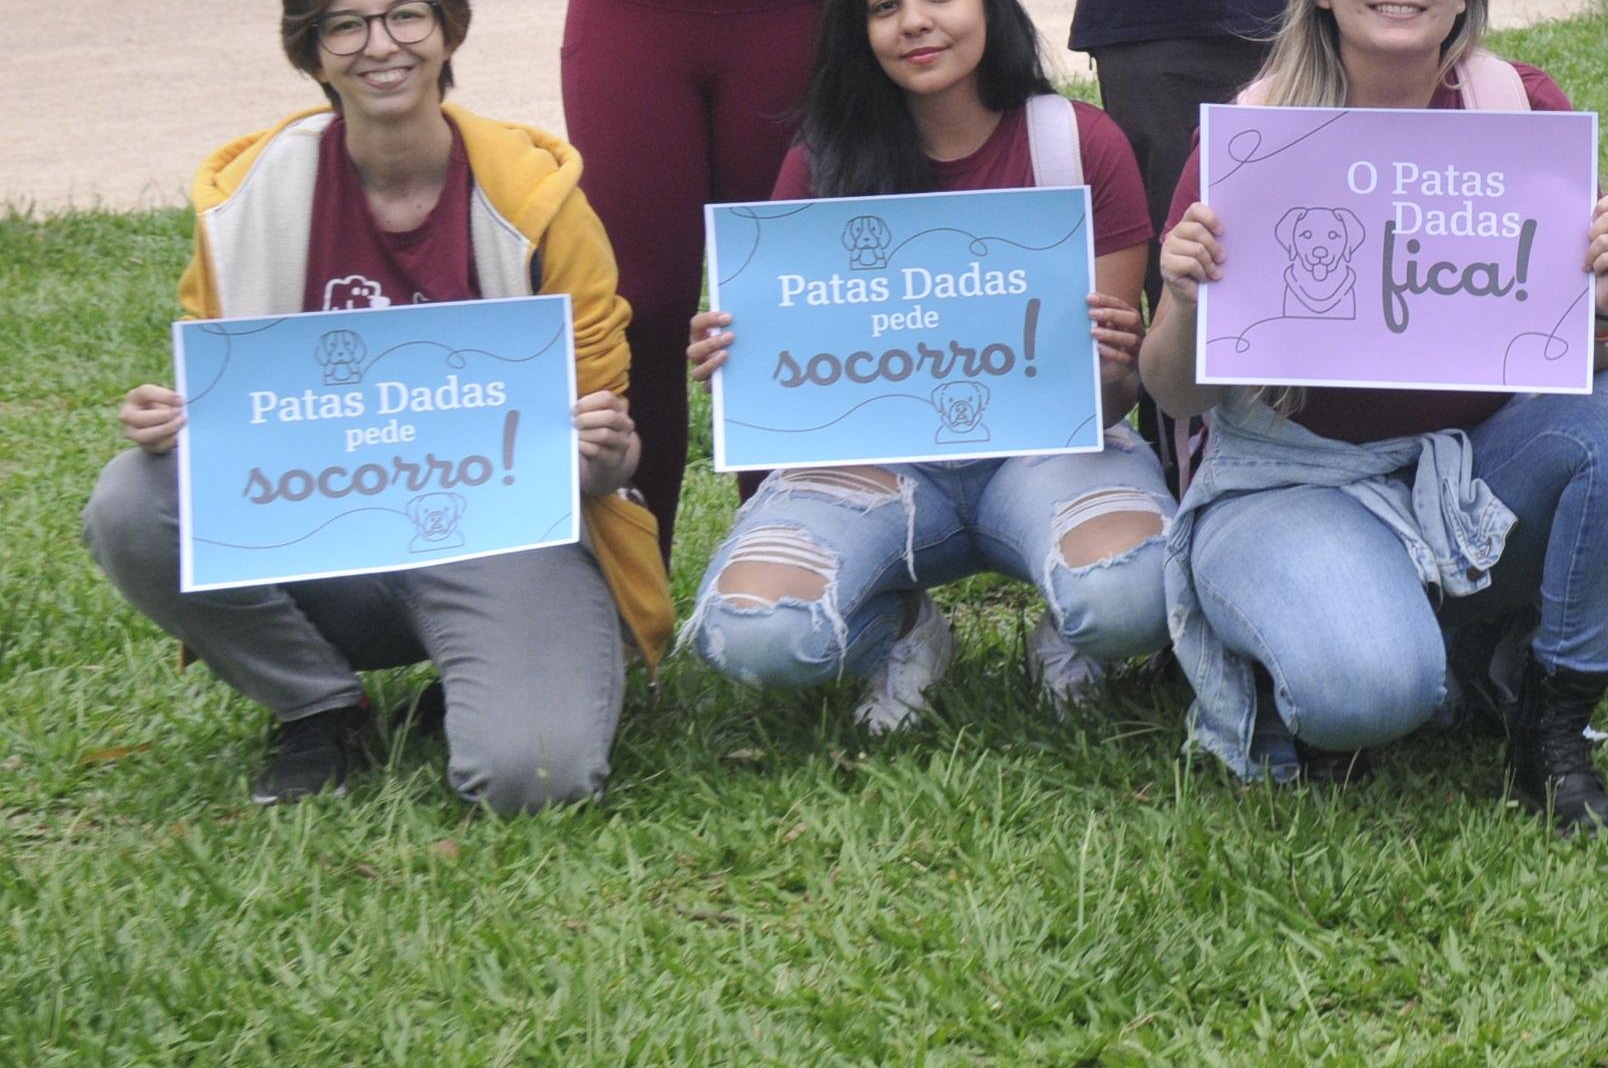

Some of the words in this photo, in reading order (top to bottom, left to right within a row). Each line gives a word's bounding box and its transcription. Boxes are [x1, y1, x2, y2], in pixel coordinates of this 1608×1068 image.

[1347, 161, 1377, 194] O
[1392, 162, 1505, 197] Patas
[1391, 200, 1521, 237] Dadas
[778, 273, 890, 307] Patas
[901, 262, 1028, 300] Dadas
[1382, 219, 1537, 334] fica!
[773, 298, 1041, 388] socorro!
[871, 305, 939, 337] pede
[249, 388, 366, 424] Patas
[376, 375, 507, 415] Dadas
[242, 409, 520, 505] socorro!
[344, 419, 416, 452] pede
